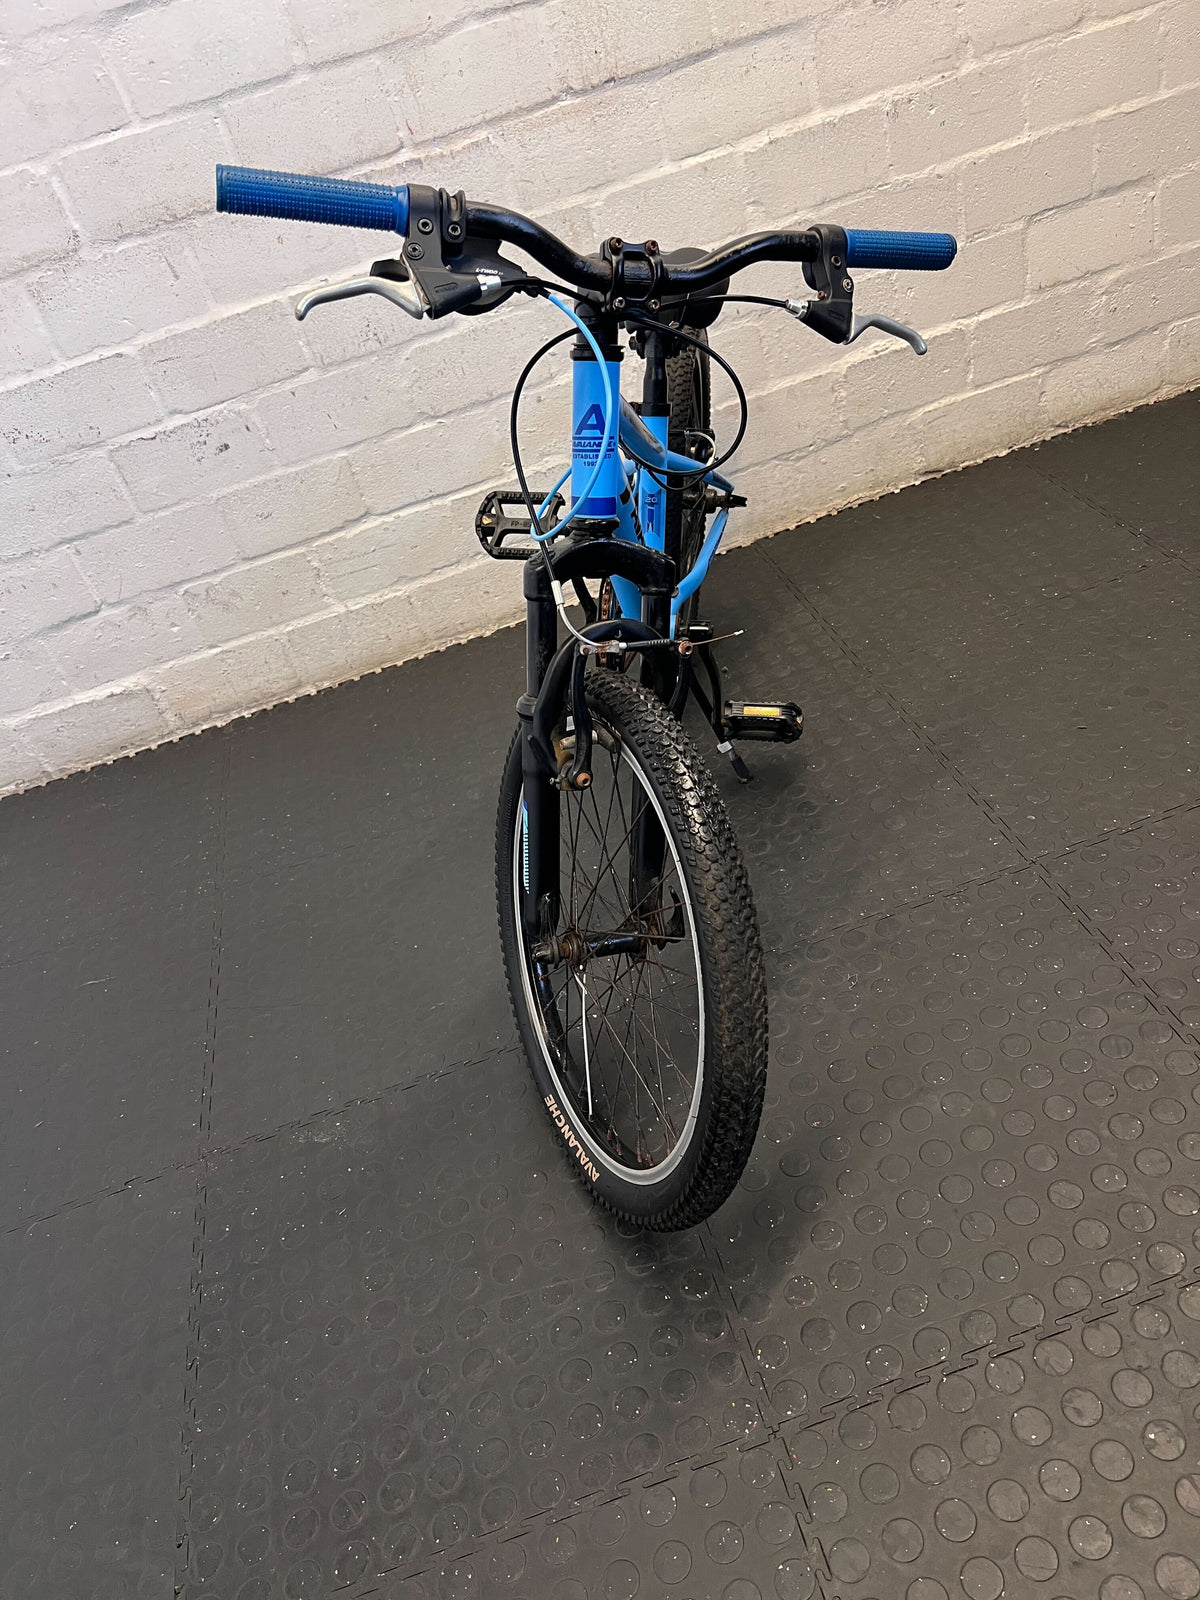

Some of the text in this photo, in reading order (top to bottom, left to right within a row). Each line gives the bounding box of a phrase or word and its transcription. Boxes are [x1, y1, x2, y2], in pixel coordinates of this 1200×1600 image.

[575, 403, 606, 435] A
[645, 496, 658, 504] 20
[544, 1094, 600, 1182] AVALANCHE
